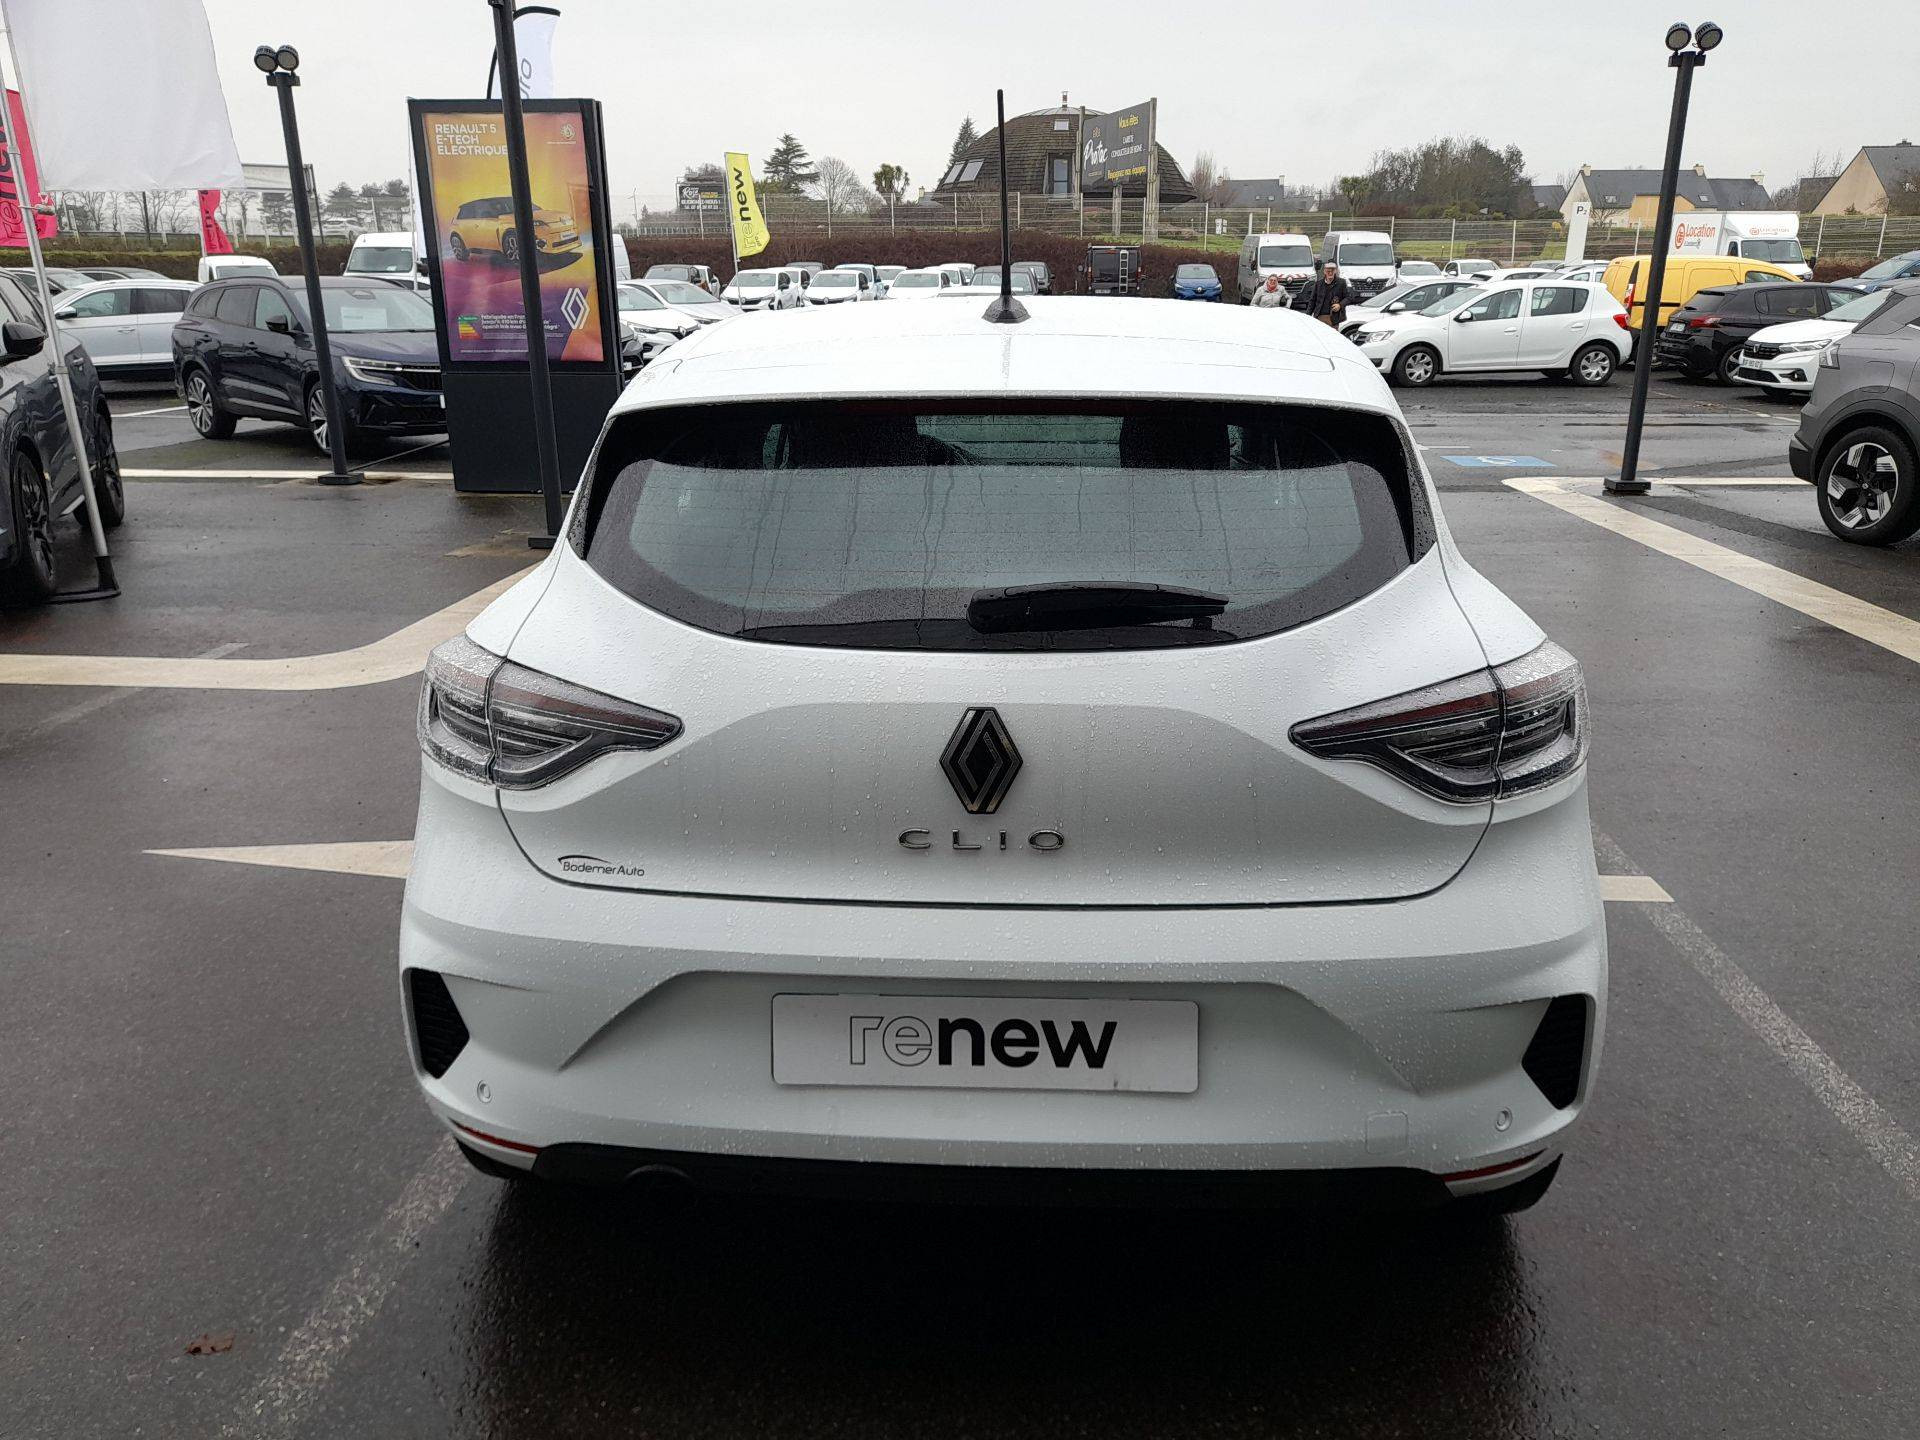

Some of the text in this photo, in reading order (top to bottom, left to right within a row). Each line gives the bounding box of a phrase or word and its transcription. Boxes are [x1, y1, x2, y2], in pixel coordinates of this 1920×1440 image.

[434, 123, 497, 134] RENAULT 5
[436, 134, 480, 145] E-TECH
[437, 145, 508, 156] ELECTRIQUE
[733, 167, 757, 249] renew
[1685, 223, 1716, 239] Location
[898, 828, 1064, 850] CLIO
[617, 865, 645, 877] Auto
[850, 1015, 1118, 1069] renew
